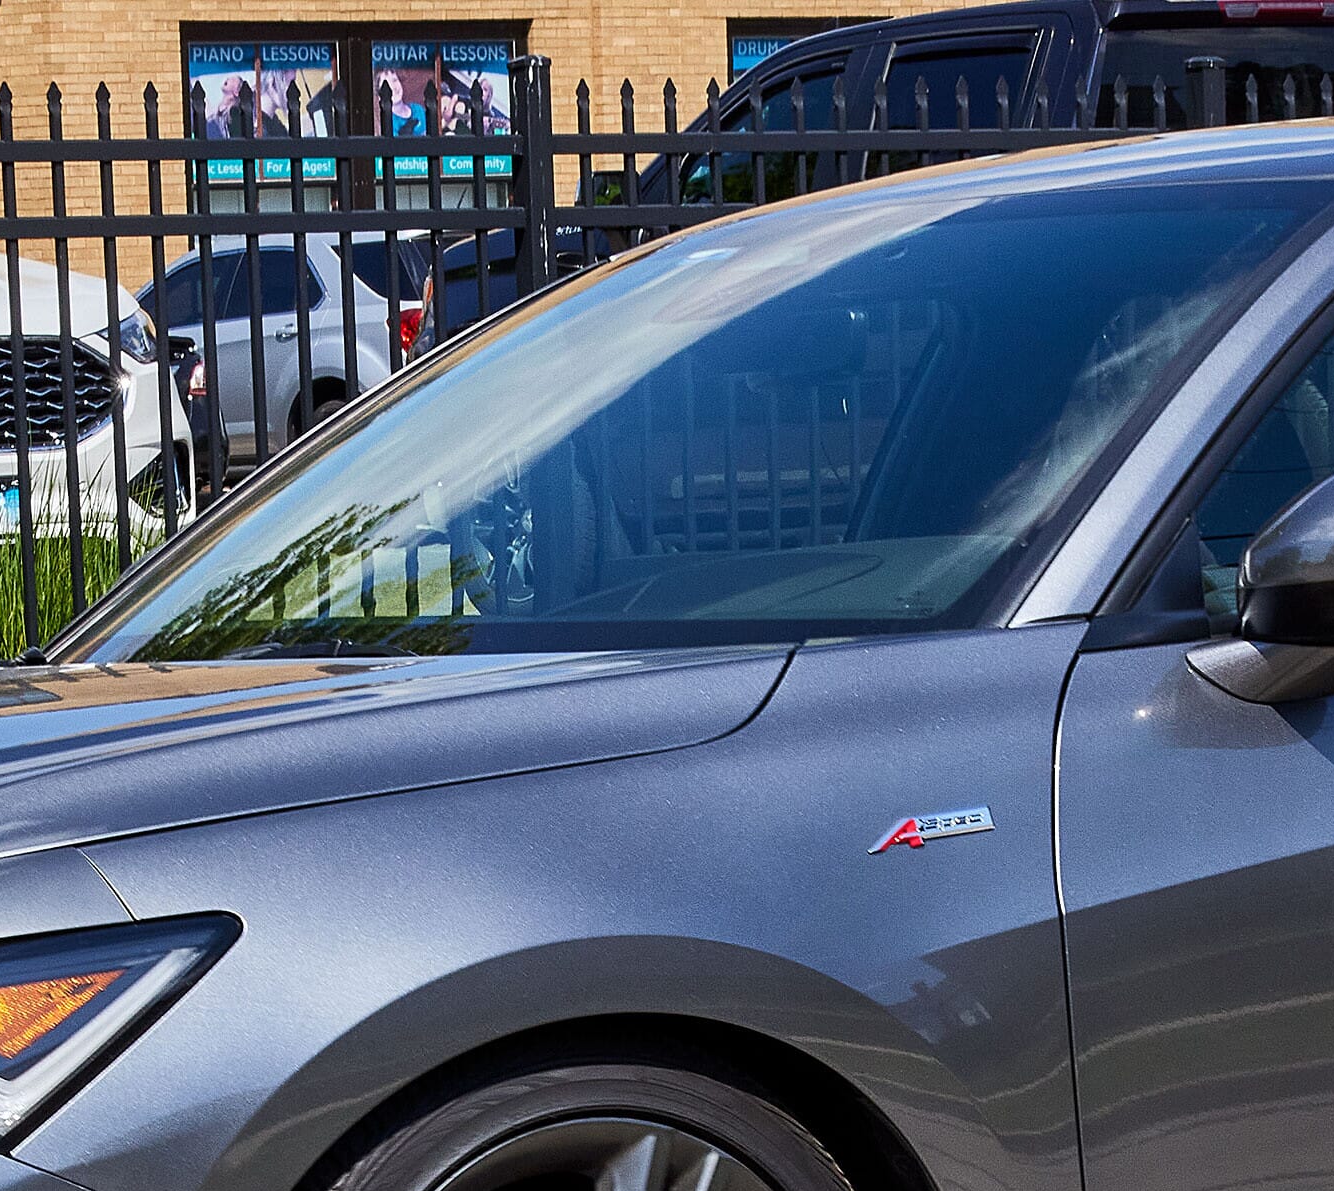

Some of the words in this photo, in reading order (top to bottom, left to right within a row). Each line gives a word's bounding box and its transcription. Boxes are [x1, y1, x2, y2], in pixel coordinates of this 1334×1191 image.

[193, 46, 244, 62] PIANO
[262, 45, 330, 62] LESSONS
[372, 44, 428, 61] GUITAR
[443, 44, 507, 61] LESSONS
[738, 41, 778, 56] DRUM
[218, 162, 244, 174] Lesso
[267, 161, 283, 172] For
[303, 161, 331, 175] Ages!
[449, 157, 506, 170] Comnity
